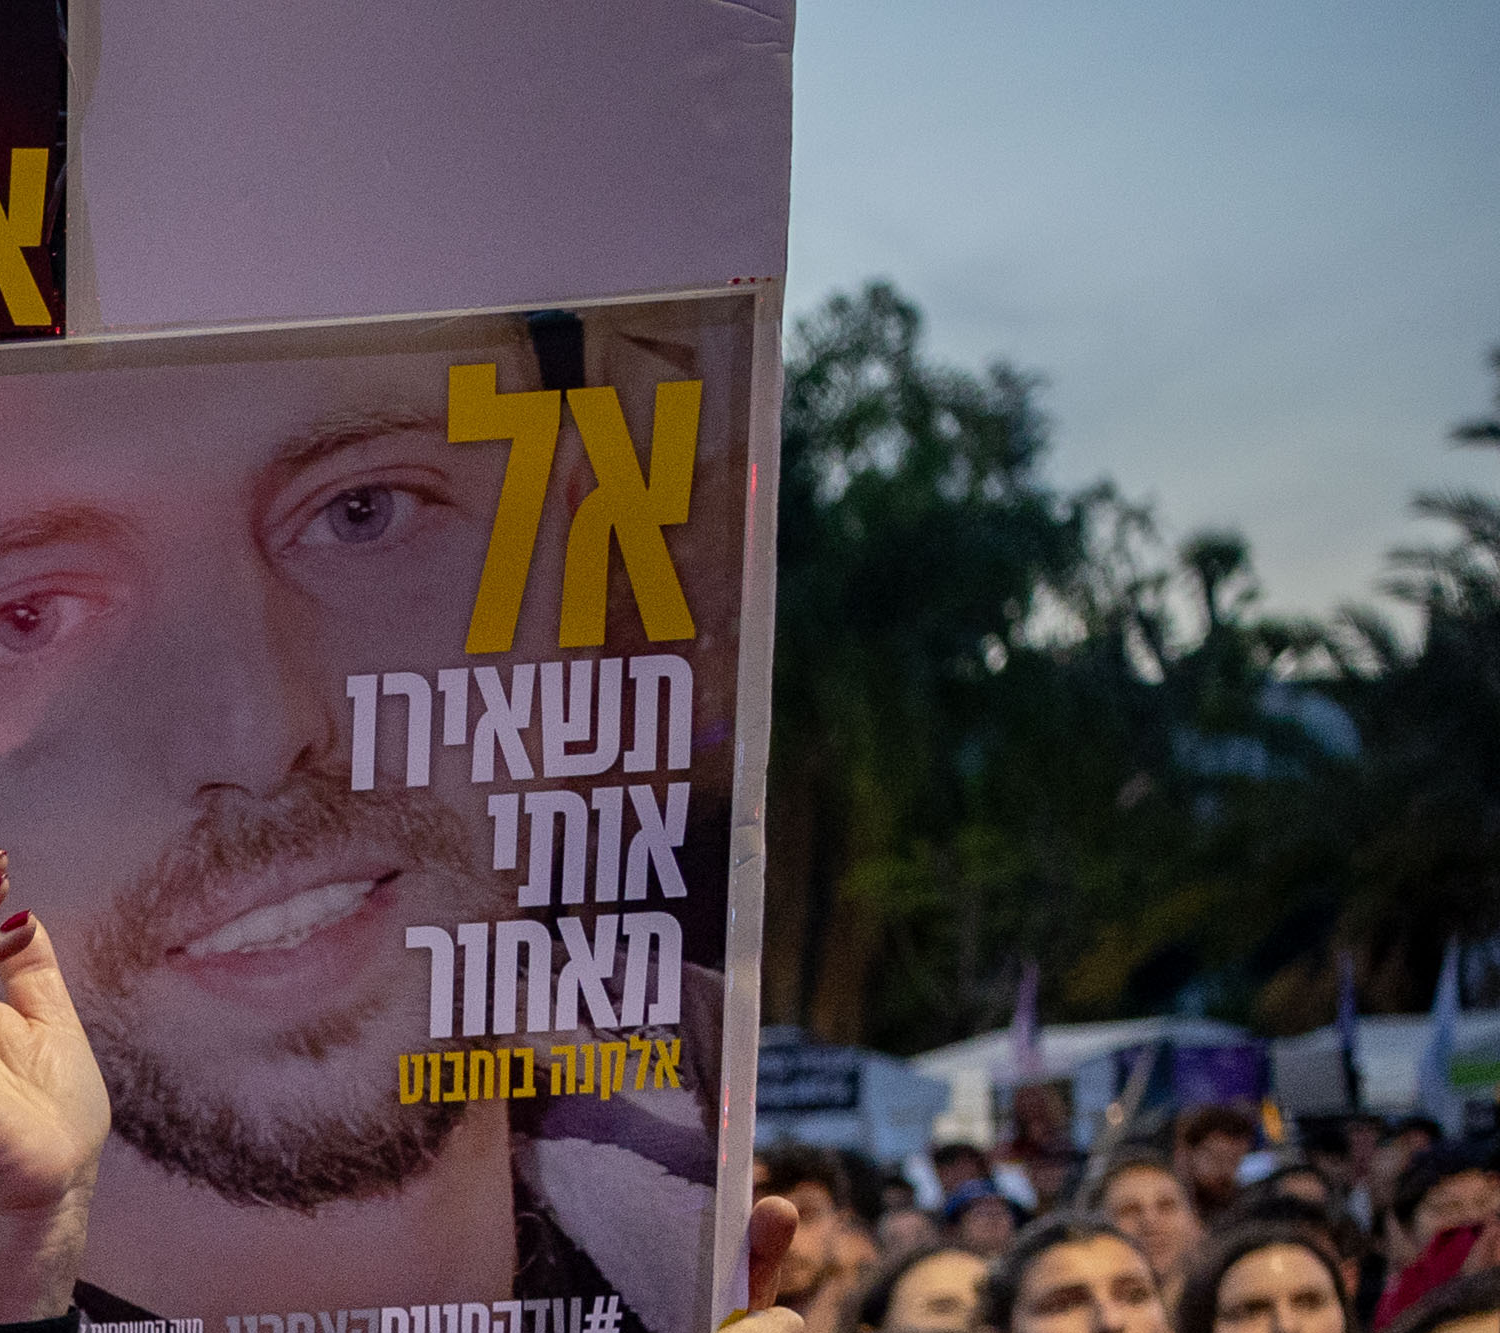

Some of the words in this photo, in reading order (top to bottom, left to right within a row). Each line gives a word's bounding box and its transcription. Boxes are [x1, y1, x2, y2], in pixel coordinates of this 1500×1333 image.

[446, 362, 703, 655] אל
[345, 653, 694, 792] תשאירו
[487, 781, 692, 908] אותי
[405, 910, 684, 1039] מאחור
[399, 1046, 537, 1105] בוחבוט
[550, 1034, 683, 1101] אלקנה
